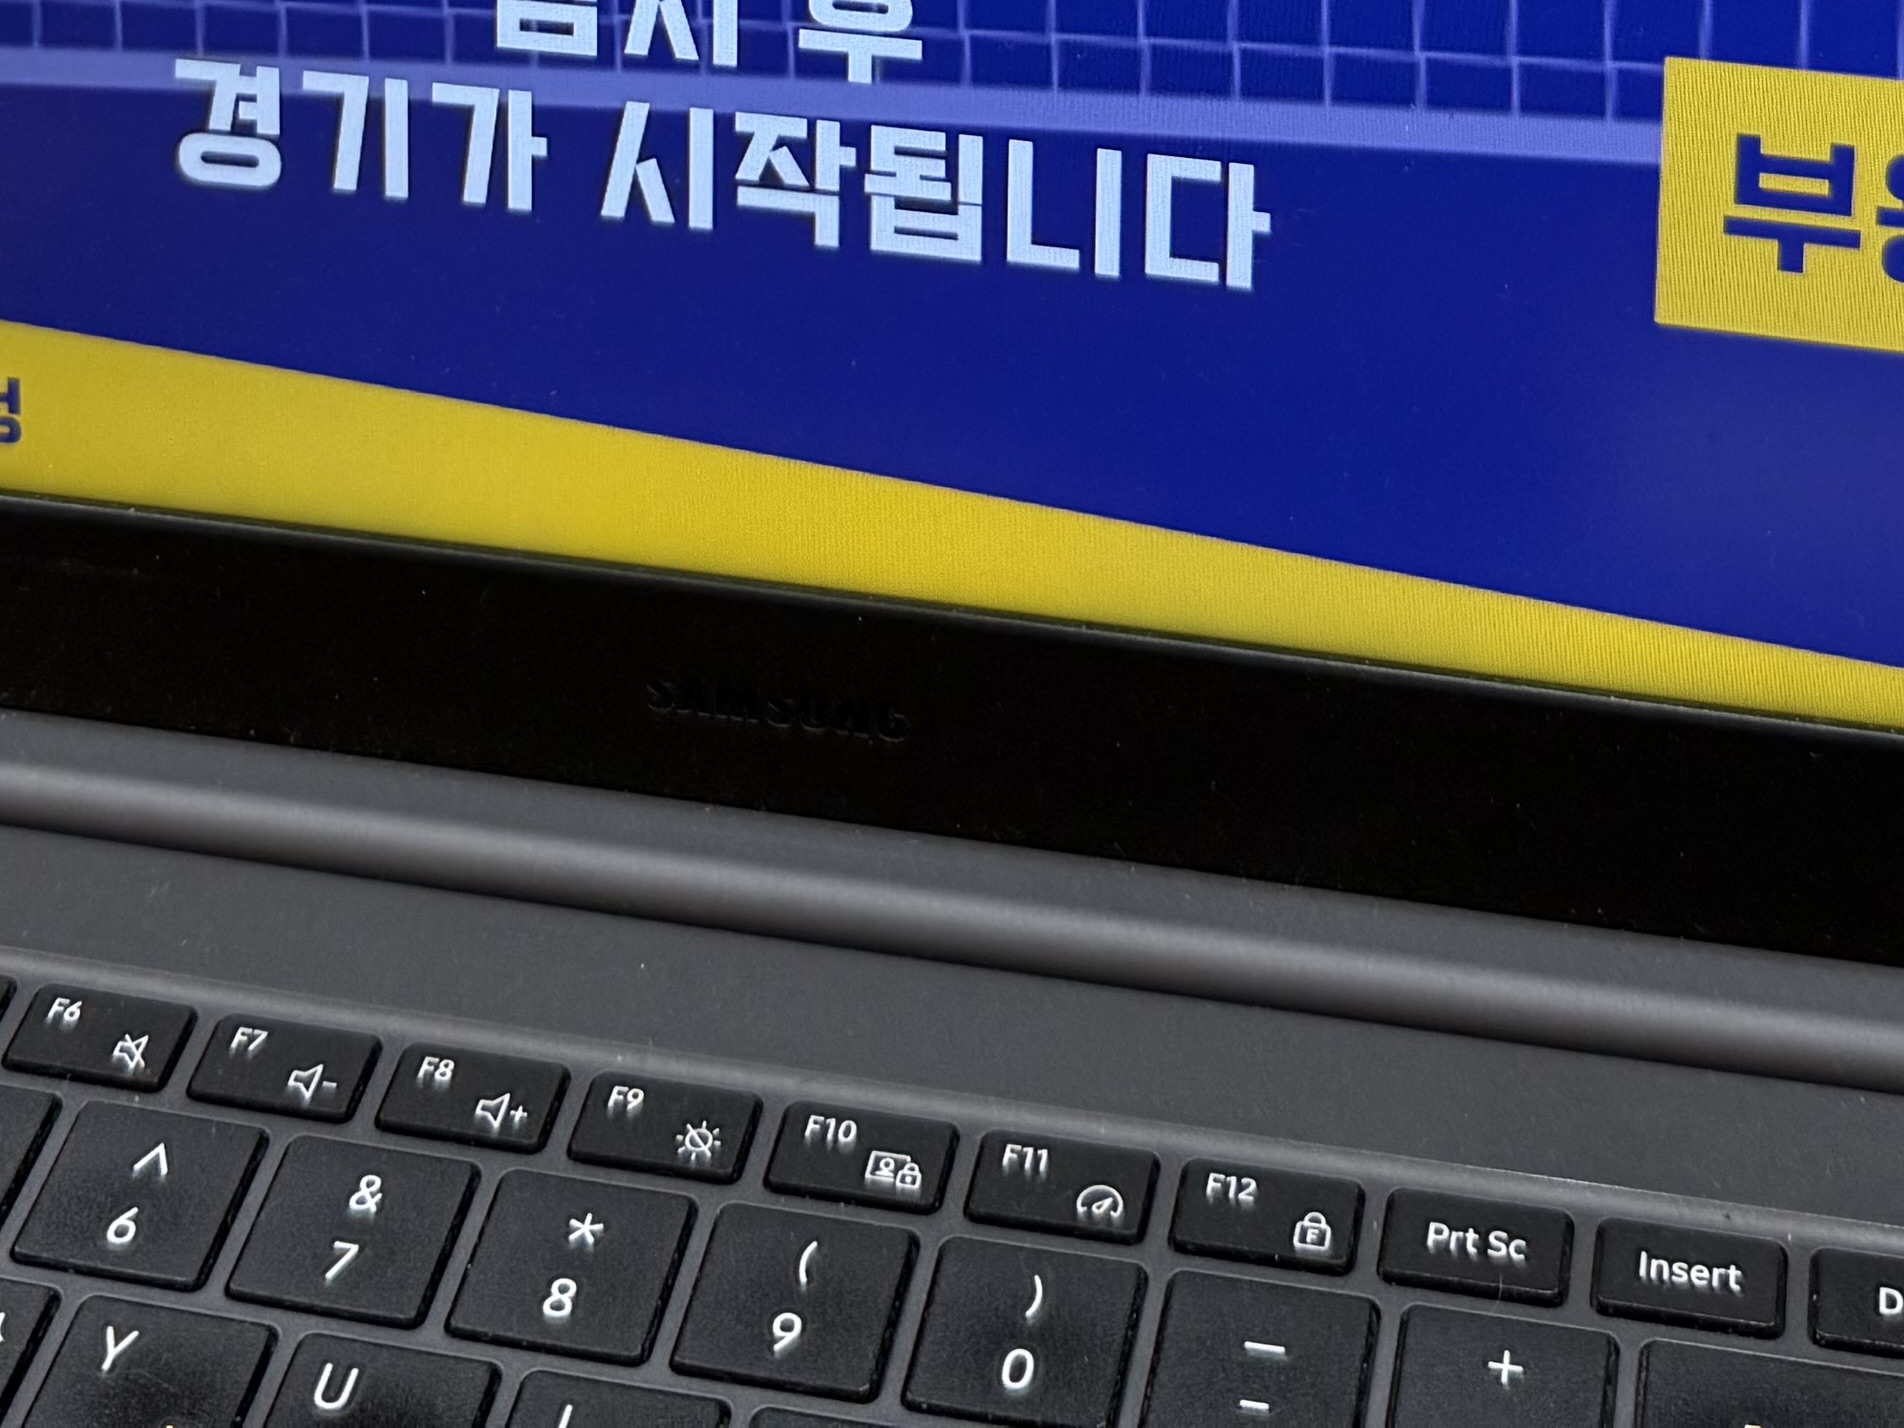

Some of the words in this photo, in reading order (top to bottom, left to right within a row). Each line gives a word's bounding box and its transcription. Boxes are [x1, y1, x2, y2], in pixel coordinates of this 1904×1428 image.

[176, 60, 546, 209] 경기가
[602, 102, 1269, 287] 시작됩니다
[48, 998, 82, 1022] F6
[231, 1027, 267, 1050] F7
[418, 1057, 454, 1082] F8
[608, 1086, 644, 1110] F9
[805, 1115, 856, 1144] F10
[134, 1143, 167, 1176] ^
[1003, 1144, 1047, 1172] F11
[349, 1175, 382, 1213] &
[1207, 1173, 1256, 1201] F12
[107, 1207, 138, 1244] 6
[1427, 1222, 1478, 1255] Prt
[1488, 1231, 1525, 1260] Sc
[326, 1241, 358, 1280] 7
[799, 1241, 817, 1284] (
[1640, 1252, 1741, 1291] Insert
[543, 1278, 576, 1317] 8
[1026, 1275, 1042, 1317] )
[102, 1326, 138, 1371] Y
[773, 1313, 801, 1352] 9
[314, 1363, 358, 1409] U
[1002, 1349, 1034, 1389] 0
[1488, 1350, 1523, 1384] +
